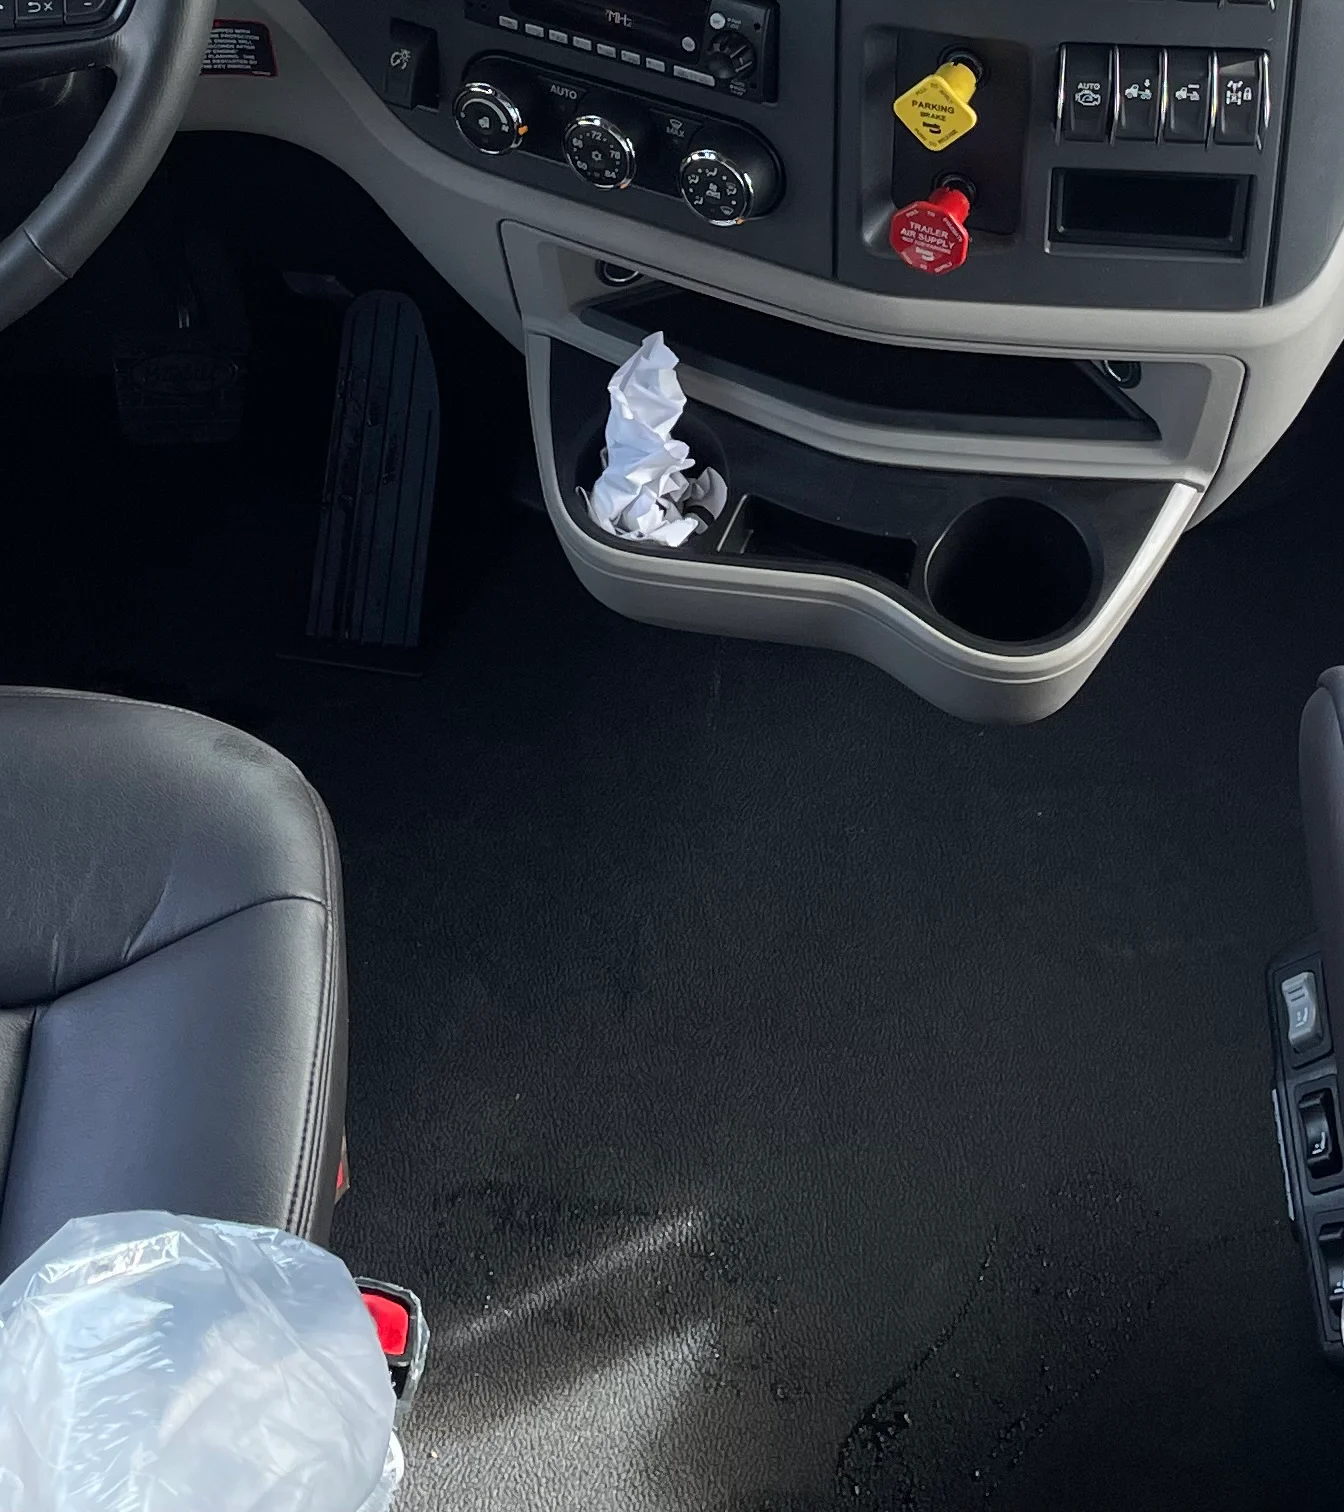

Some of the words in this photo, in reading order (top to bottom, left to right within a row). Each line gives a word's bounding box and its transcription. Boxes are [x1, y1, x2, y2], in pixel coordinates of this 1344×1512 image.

[549, 84, 578, 100] AUTO
[912, 100, 954, 114] PARKING
[920, 112, 946, 121] BRAKE
[591, 131, 602, 140] 72
[666, 126, 686, 138] MAX
[910, 221, 948, 239] TRAILER
[901, 228, 916, 237] AIR
[918, 233, 955, 249] SUPPLY
